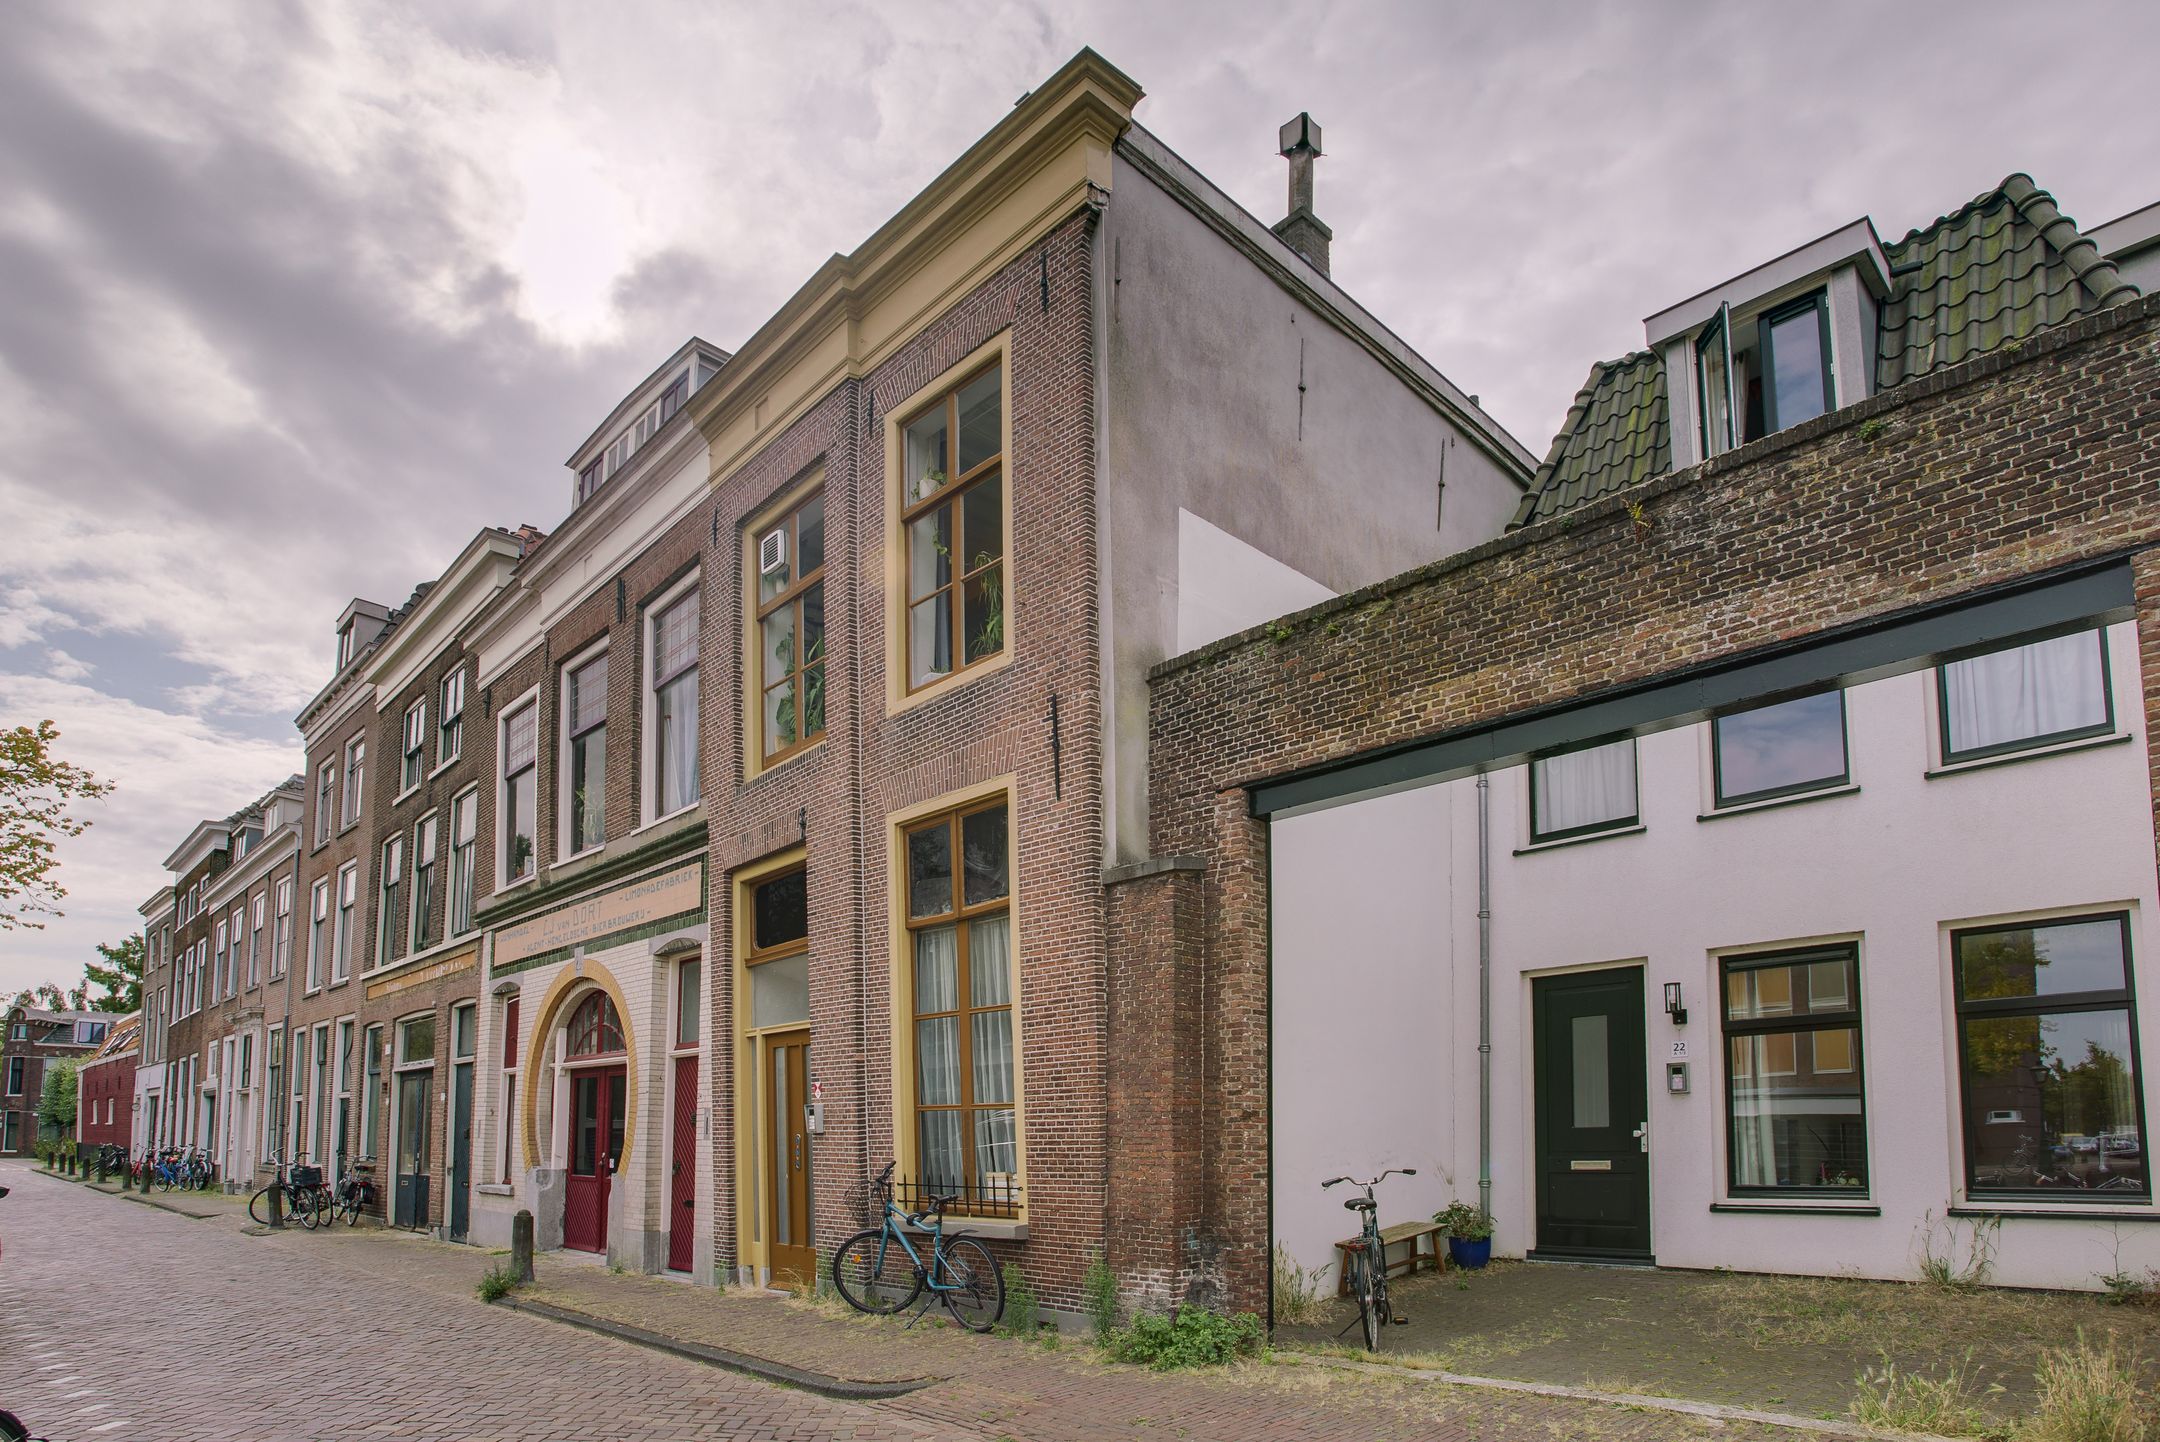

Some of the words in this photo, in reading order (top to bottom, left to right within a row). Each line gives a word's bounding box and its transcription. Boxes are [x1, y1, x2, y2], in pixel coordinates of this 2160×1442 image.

[624, 870, 693, 901] LIMONADEFABRIEK
[557, 919, 570, 931] VAN
[573, 900, 603, 926] DORT
[1673, 1042, 1686, 1051] 22
